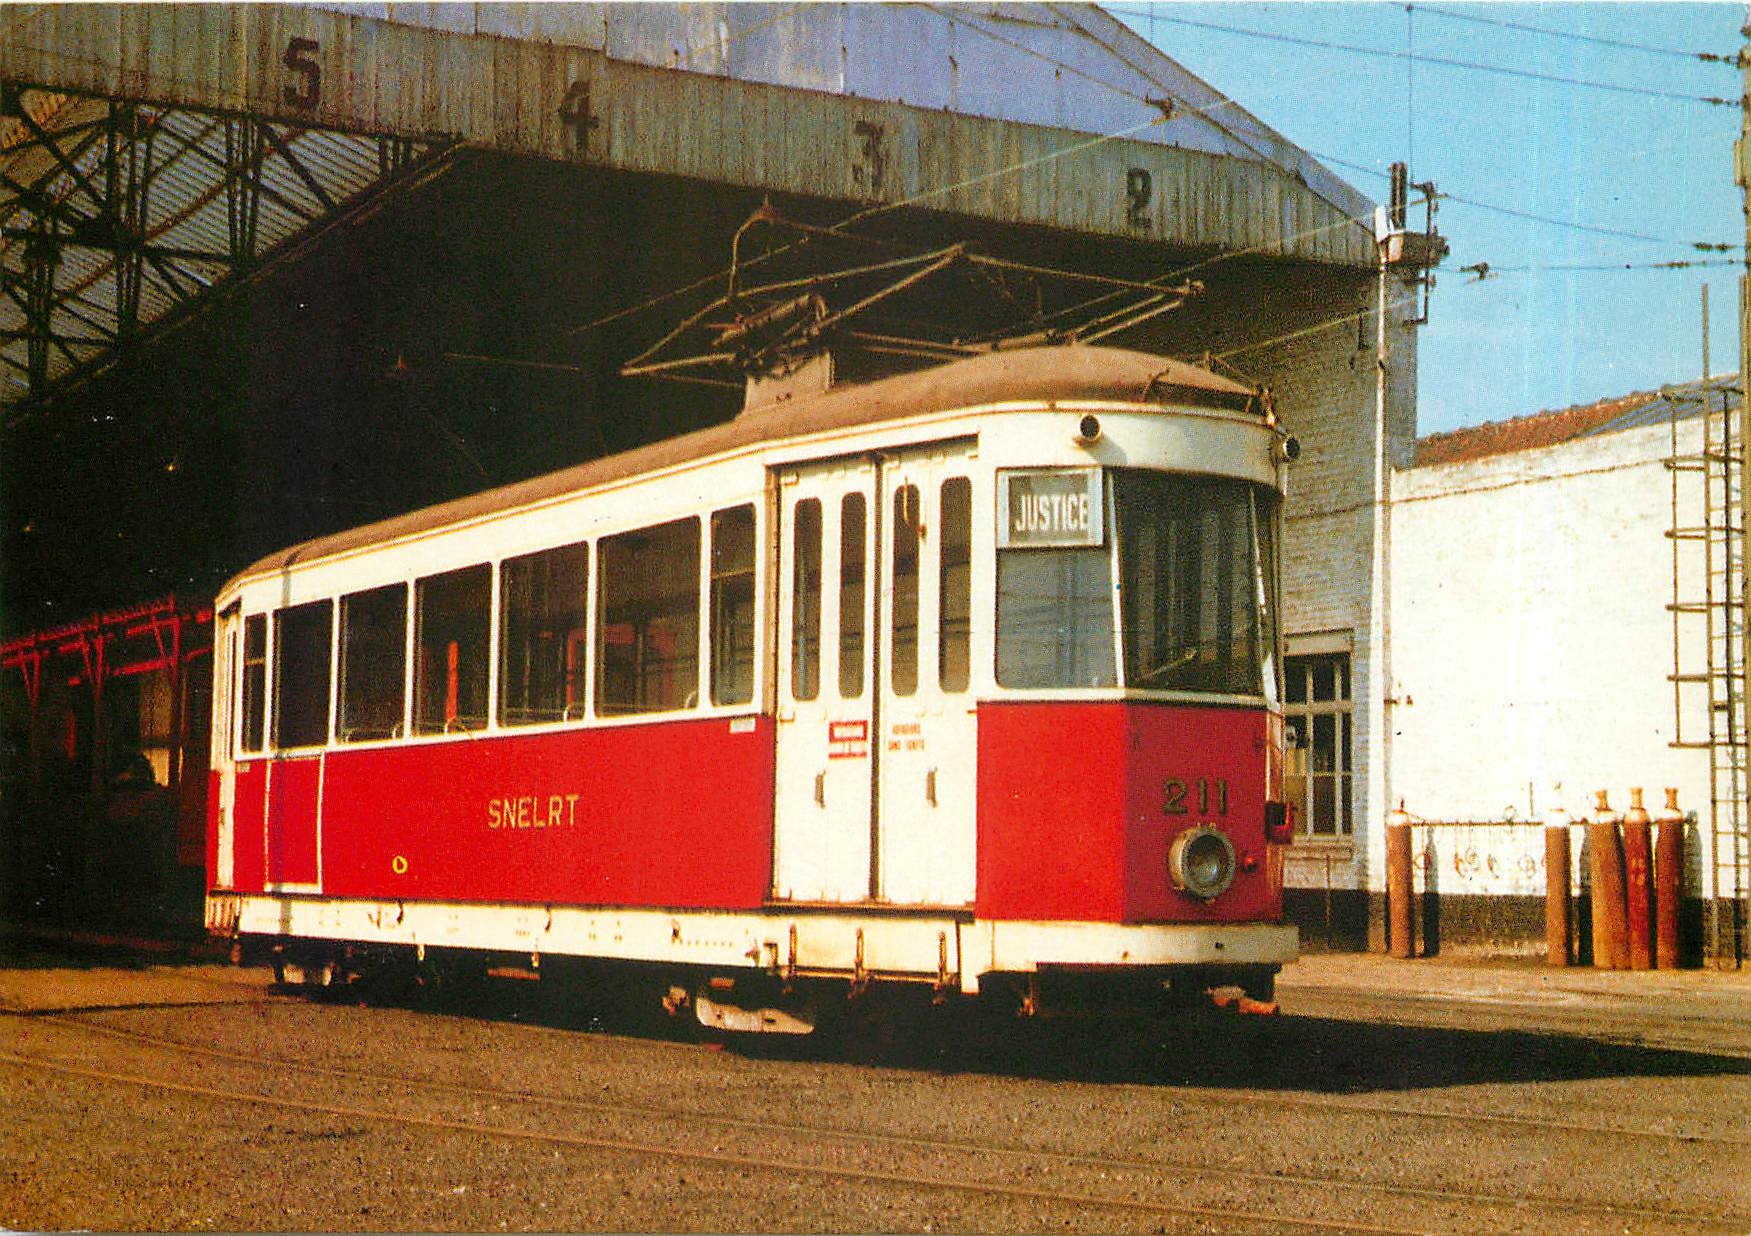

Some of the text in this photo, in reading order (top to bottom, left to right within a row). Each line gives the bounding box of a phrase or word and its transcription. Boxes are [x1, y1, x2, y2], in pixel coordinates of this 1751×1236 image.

[285, 37, 320, 110] 5
[559, 80, 599, 151] 4
[1014, 494, 1089, 531] JUSTICE
[1163, 778, 1227, 815] 211
